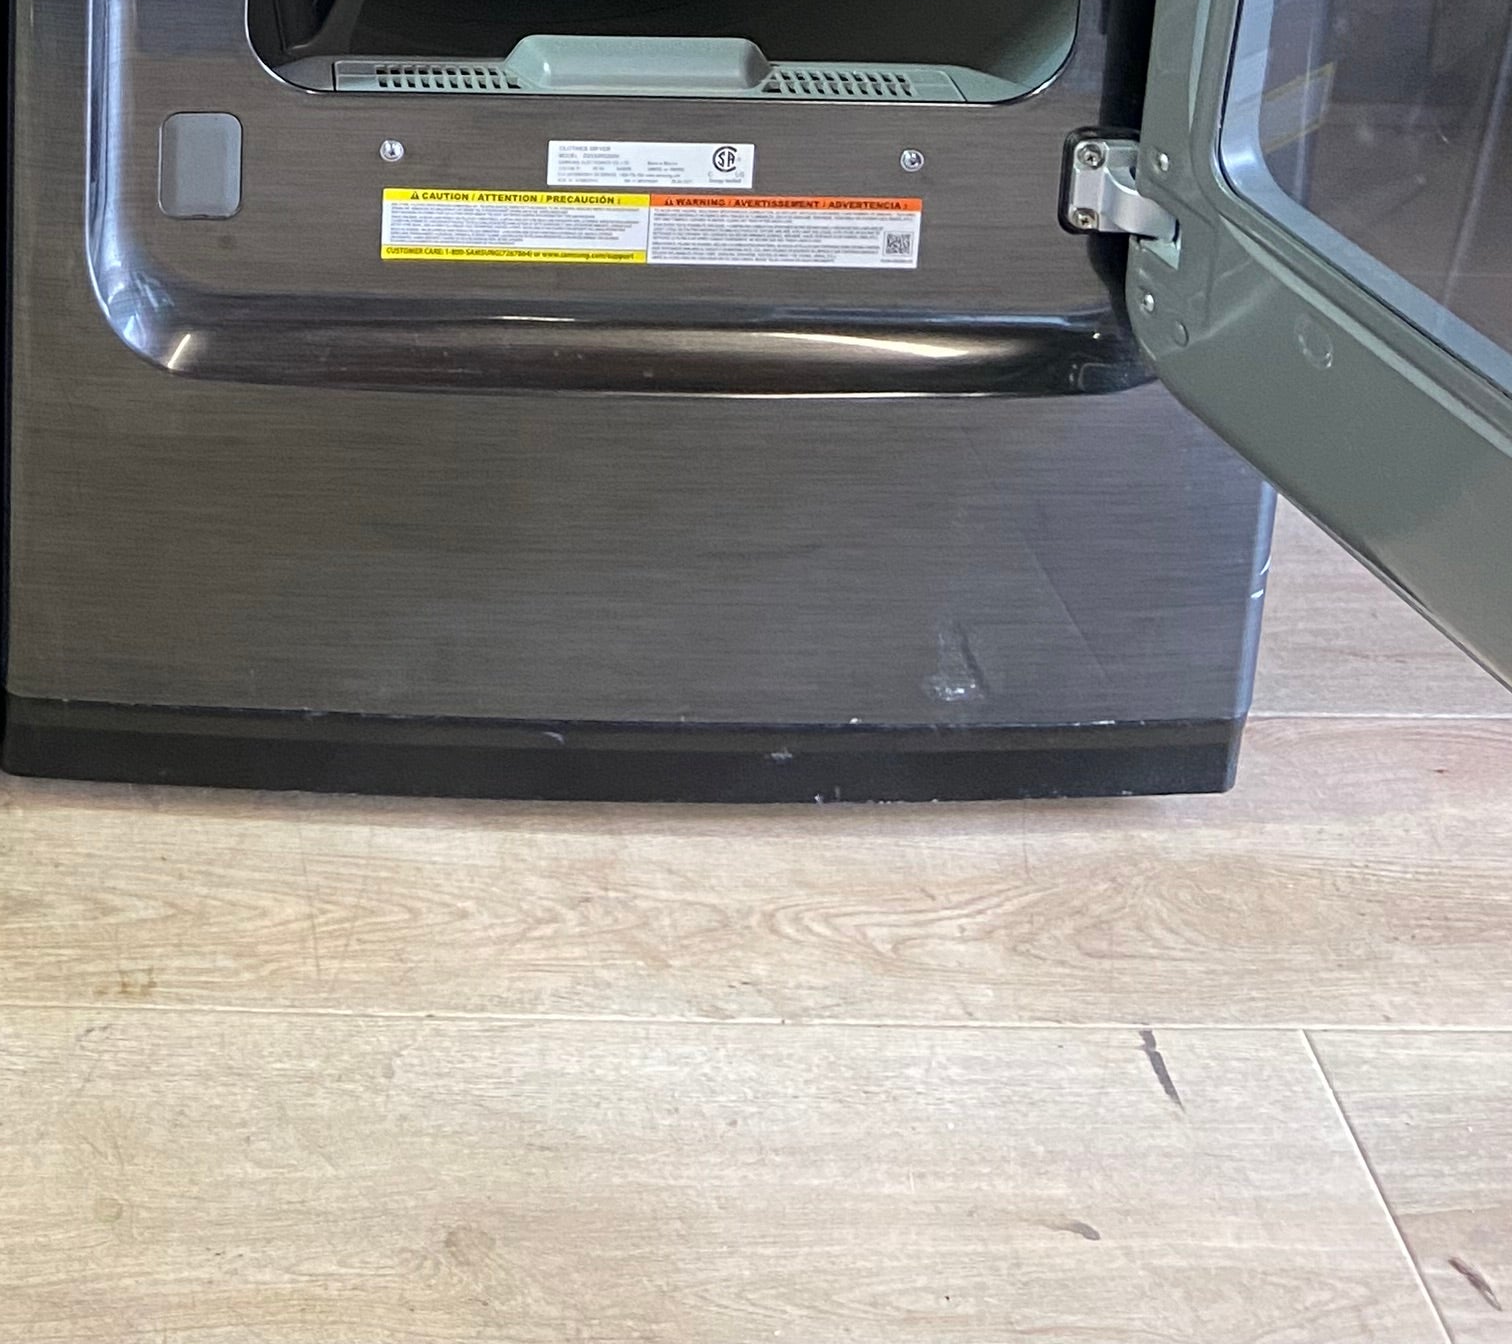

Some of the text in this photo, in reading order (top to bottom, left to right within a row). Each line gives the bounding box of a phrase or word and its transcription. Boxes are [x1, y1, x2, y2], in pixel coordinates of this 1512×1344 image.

[422, 192, 469, 201] CAUTION
[478, 193, 537, 203] ATTENTION
[546, 193, 615, 205] PRECAUCIÓN
[675, 198, 726, 207] WARNING
[734, 199, 820, 209] AVERTISSEMENT
[828, 200, 901, 210] ADVERTENCIA
[386, 247, 423, 255] CUSTOMER
